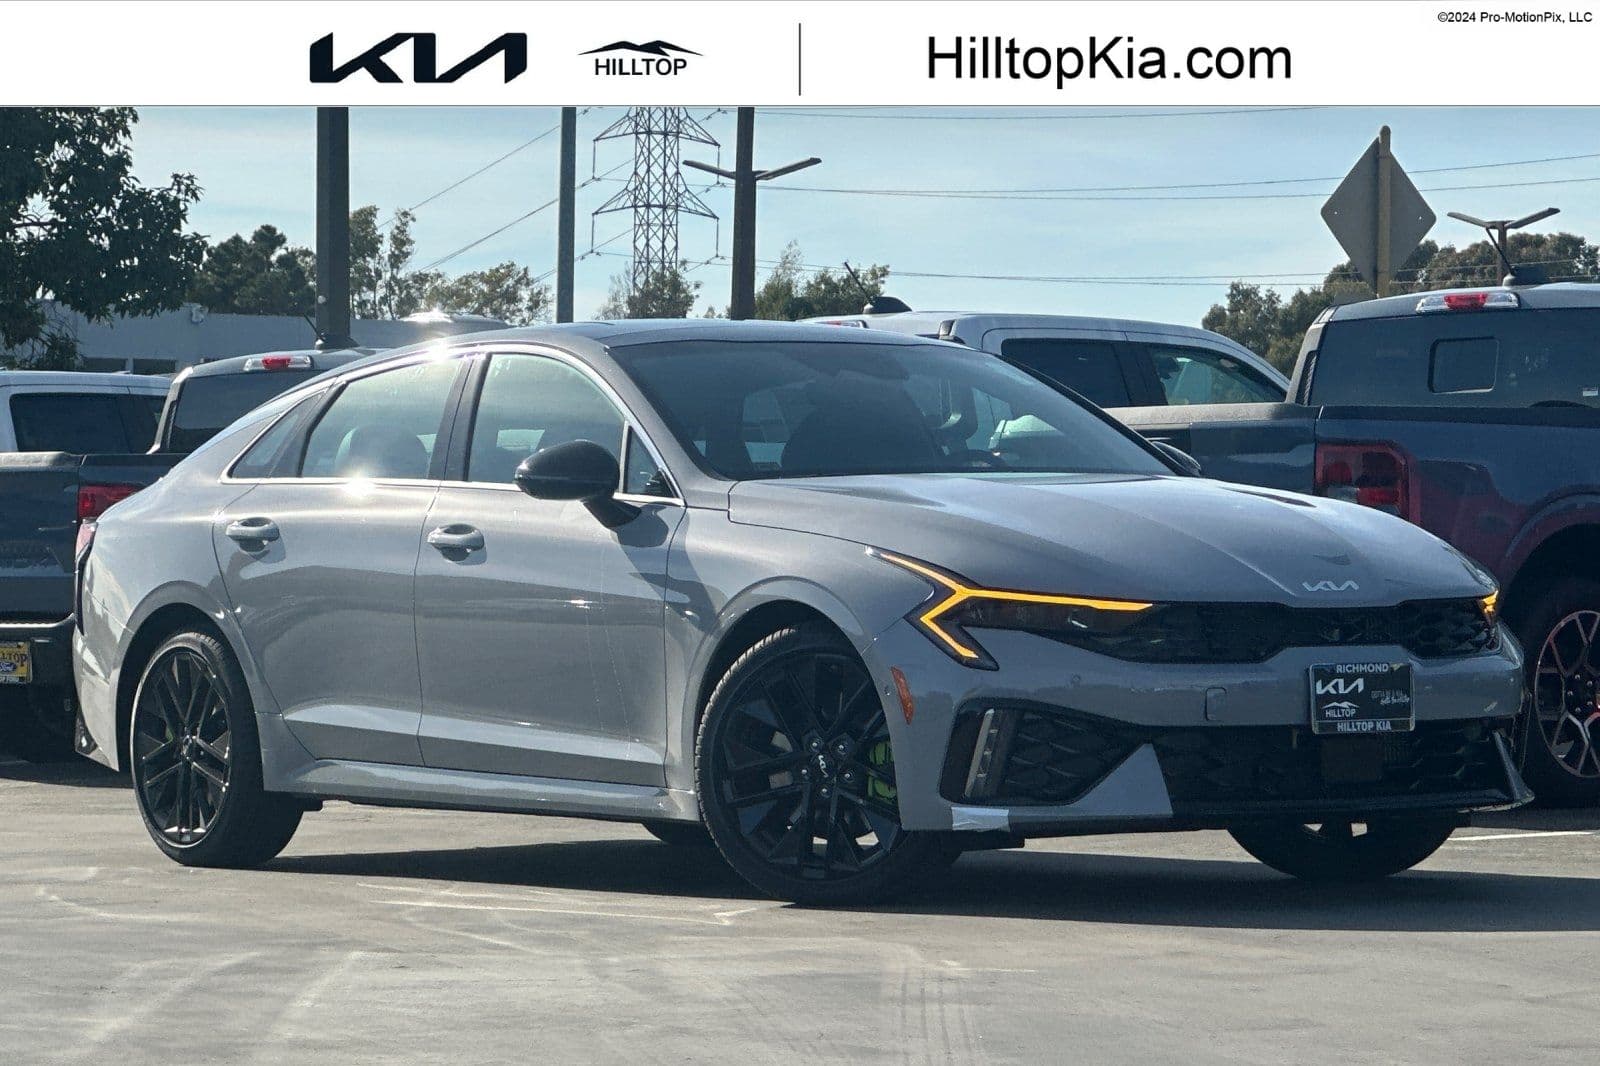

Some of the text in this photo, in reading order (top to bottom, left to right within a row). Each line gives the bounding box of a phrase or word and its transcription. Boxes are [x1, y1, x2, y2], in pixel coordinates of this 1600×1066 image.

[1336, 663, 1389, 674] RICHMOND
[1315, 677, 1364, 695] KIA
[1325, 708, 1356, 718] HILLTOP
[1337, 720, 1392, 732] HILLTOP KIA
